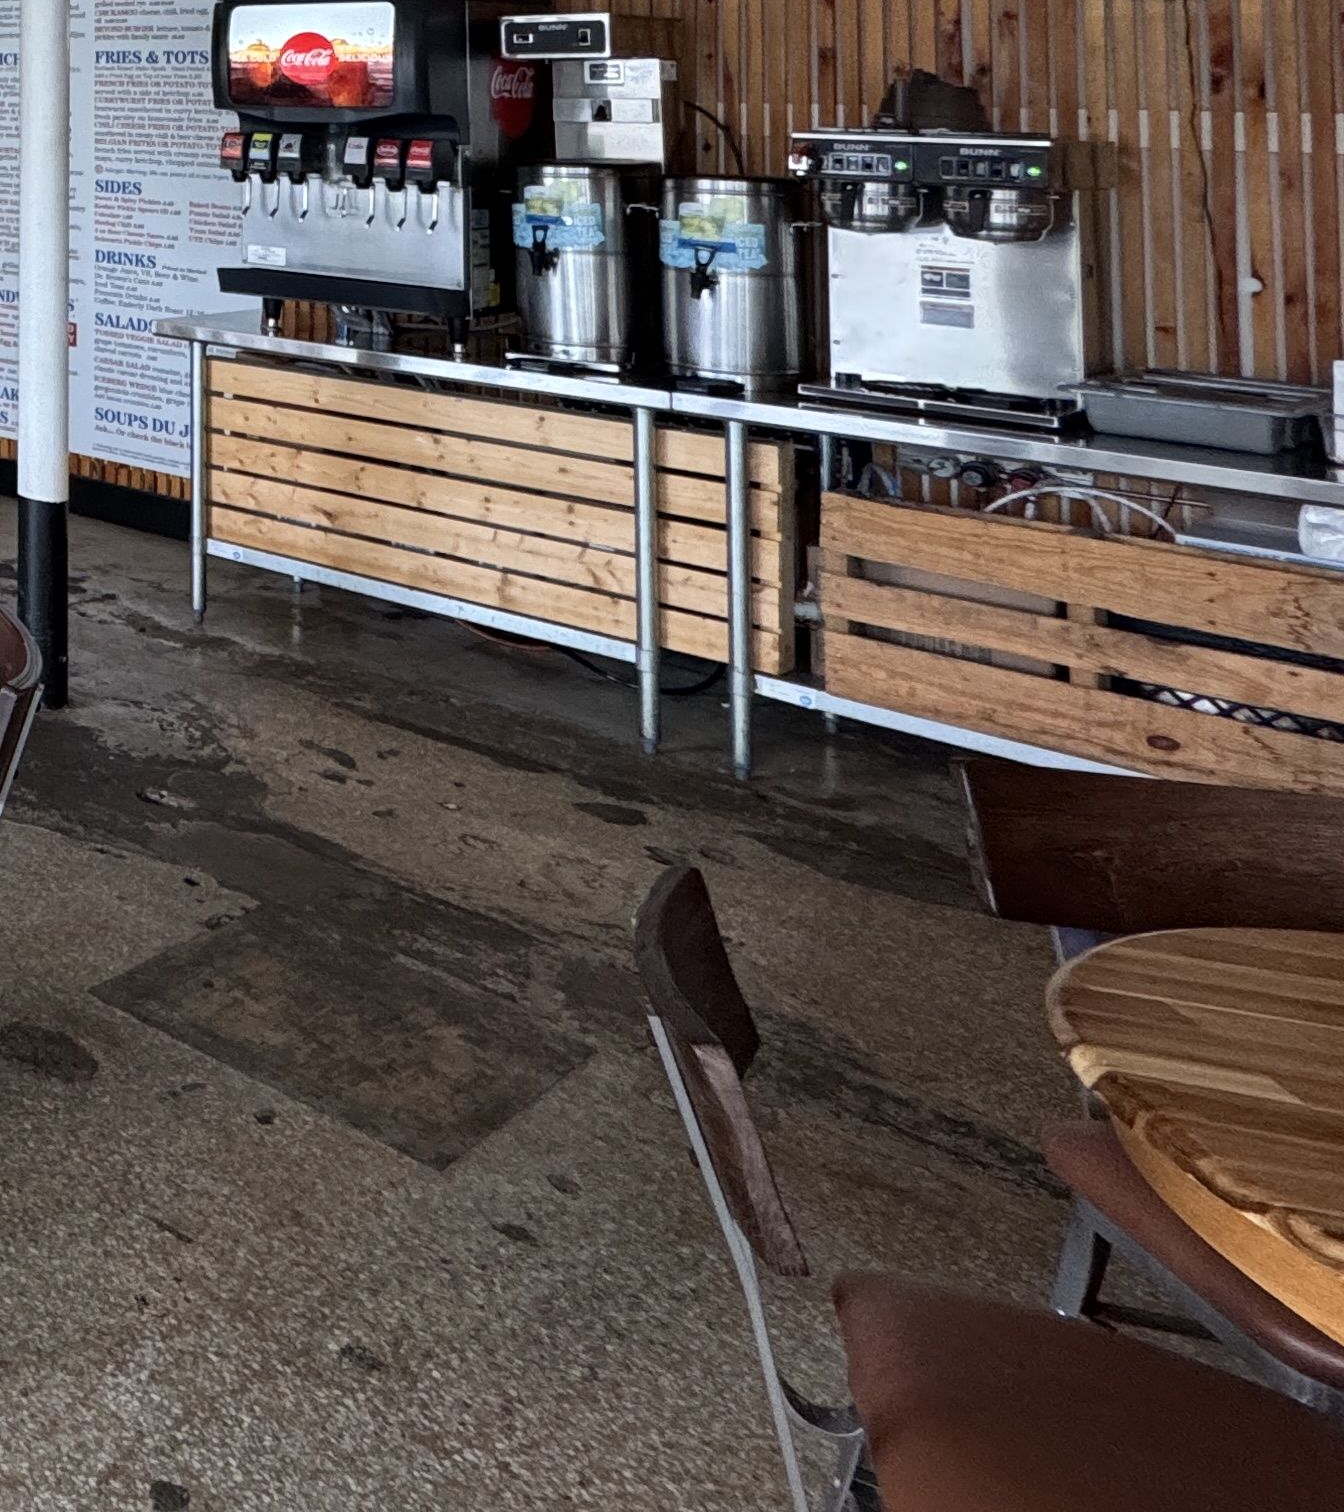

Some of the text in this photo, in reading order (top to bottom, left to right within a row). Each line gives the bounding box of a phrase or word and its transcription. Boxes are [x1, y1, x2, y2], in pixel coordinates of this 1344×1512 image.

[95, 50, 209, 64] FRIES & TOTS
[280, 49, 333, 66] Coca-Cola
[491, 65, 535, 99] Coca-Cola
[960, 148, 998, 156] BUNN
[95, 179, 142, 195] SIDES
[95, 249, 157, 269] DRINKS
[95, 407, 148, 430] SOUPS
[152, 418, 175, 434] DU
